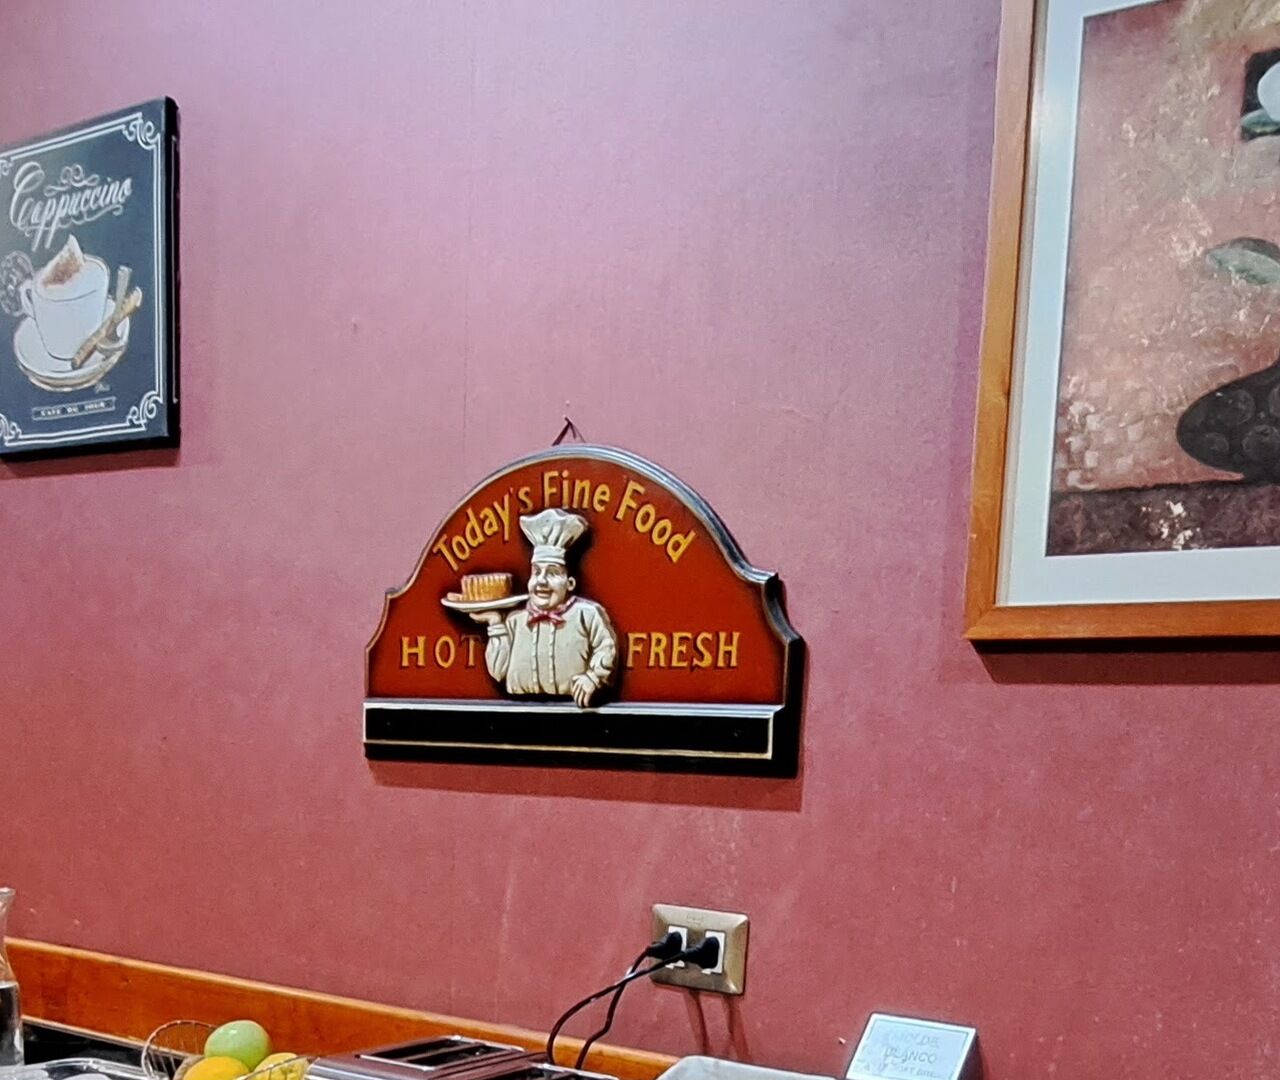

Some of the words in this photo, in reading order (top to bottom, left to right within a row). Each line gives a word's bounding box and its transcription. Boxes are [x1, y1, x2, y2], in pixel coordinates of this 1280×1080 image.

[9, 161, 132, 252] Cappuccino
[433, 484, 532, 573] Today's
[542, 470, 611, 513] Fine
[616, 477, 696, 563] Food
[400, 634, 482, 669] HOT
[626, 631, 741, 669] FRESH
